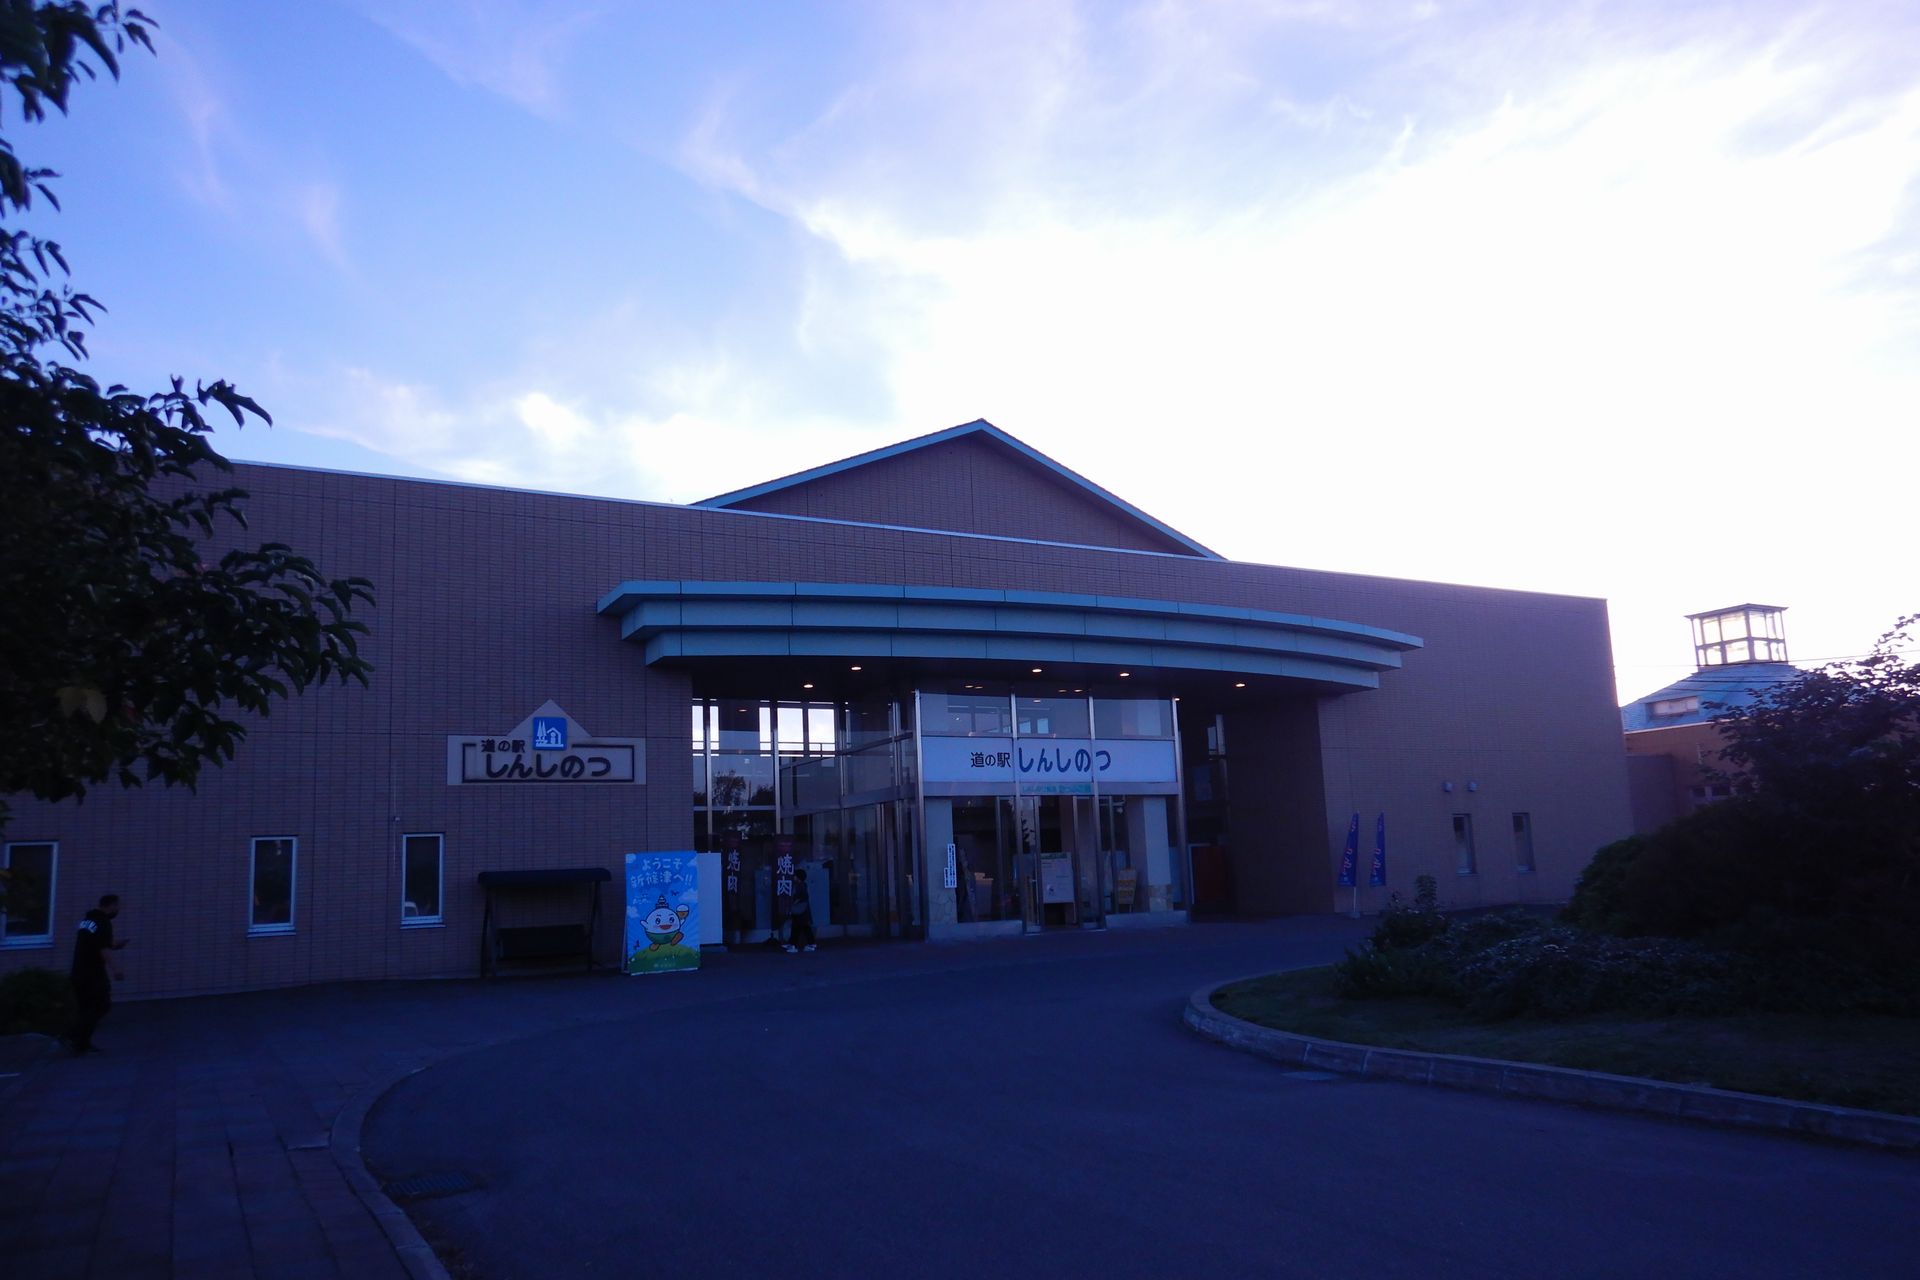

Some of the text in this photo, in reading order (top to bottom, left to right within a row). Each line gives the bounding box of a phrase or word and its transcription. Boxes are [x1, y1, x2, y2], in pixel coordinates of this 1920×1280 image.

[481, 739, 526, 753] 道の駅
[486, 753, 611, 778] しんしのつ
[970, 747, 1111, 773] 道の駅 しんしのつ
[642, 857, 683, 870] ようこそ
[726, 848, 741, 893] 焼肉
[776, 853, 795, 896] 焼肉
